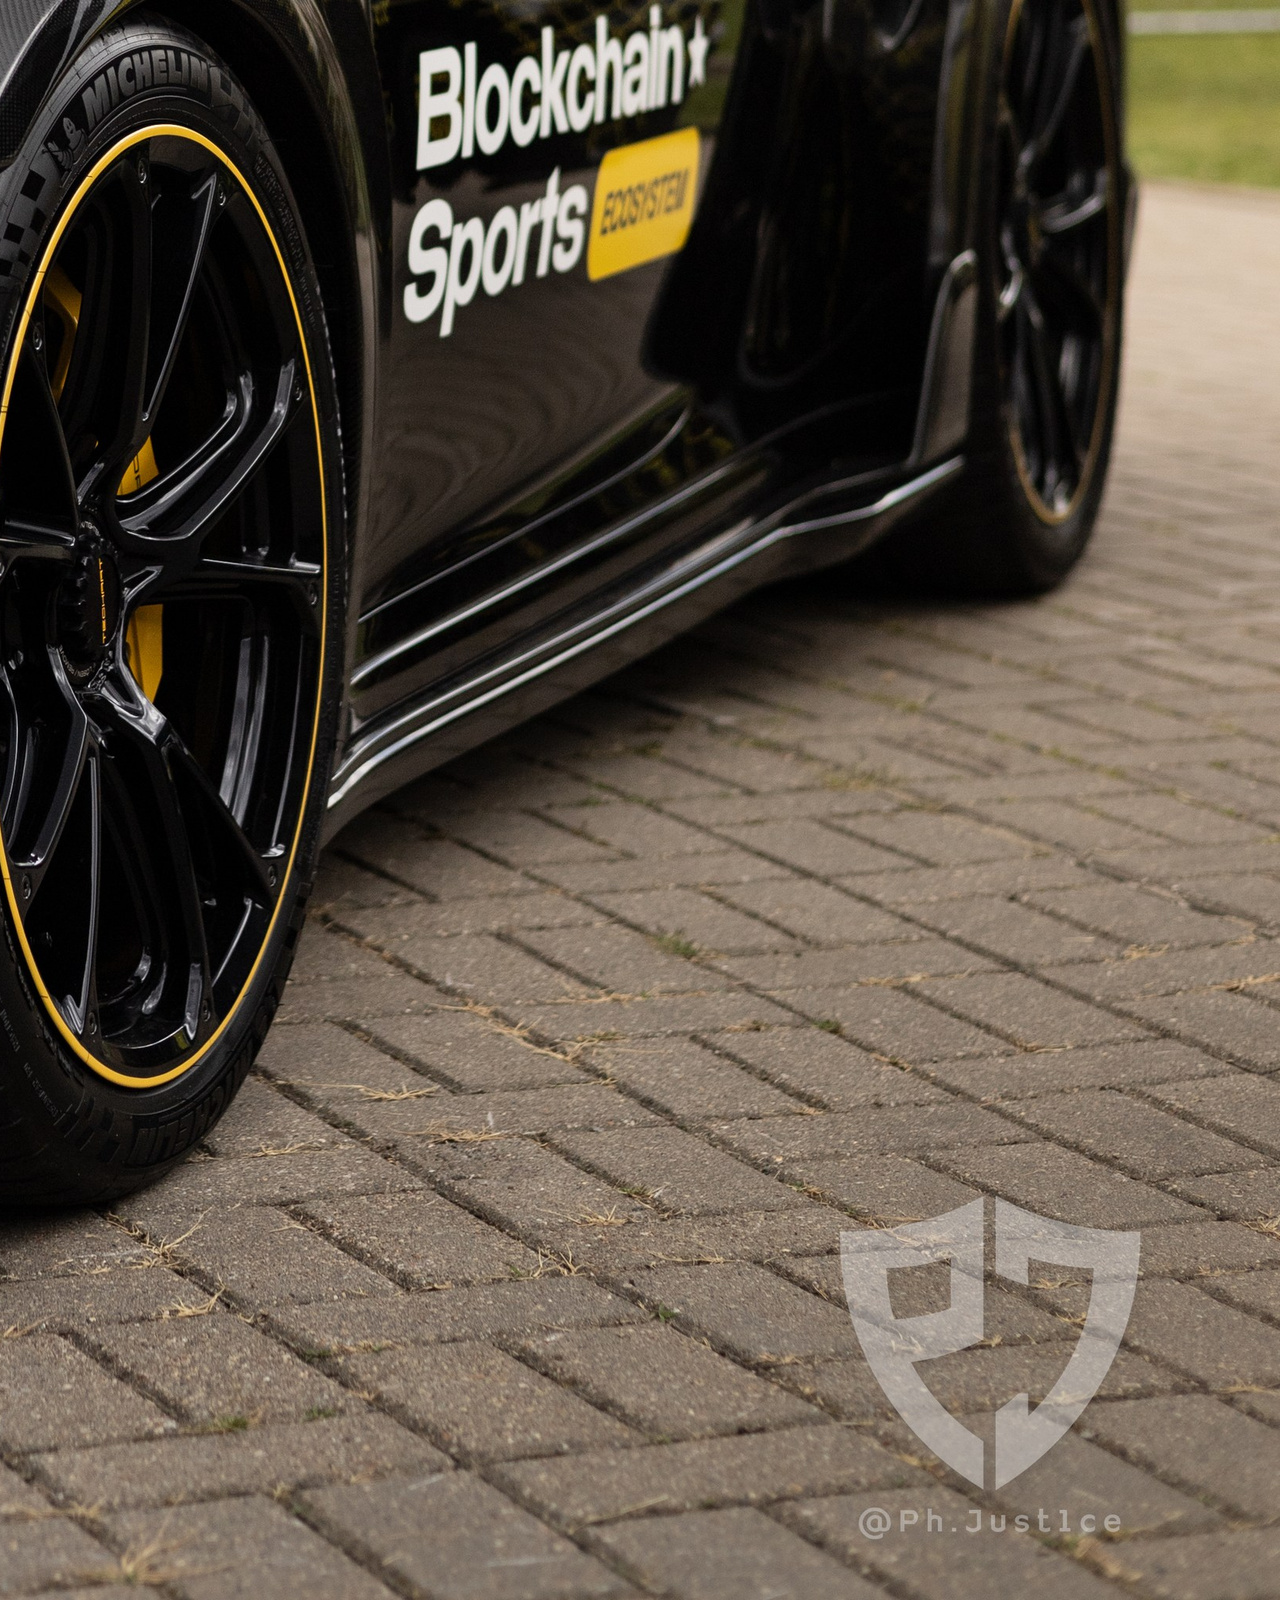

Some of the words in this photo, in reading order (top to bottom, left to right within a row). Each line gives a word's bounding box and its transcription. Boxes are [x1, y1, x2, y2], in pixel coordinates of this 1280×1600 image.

[81, 49, 208, 130] MICHELIN
[416, 4, 684, 170] Blockchain
[600, 168, 689, 236] ECOSYSTEM
[403, 166, 588, 338] Sports
[98, 557, 107, 644] TECHART
